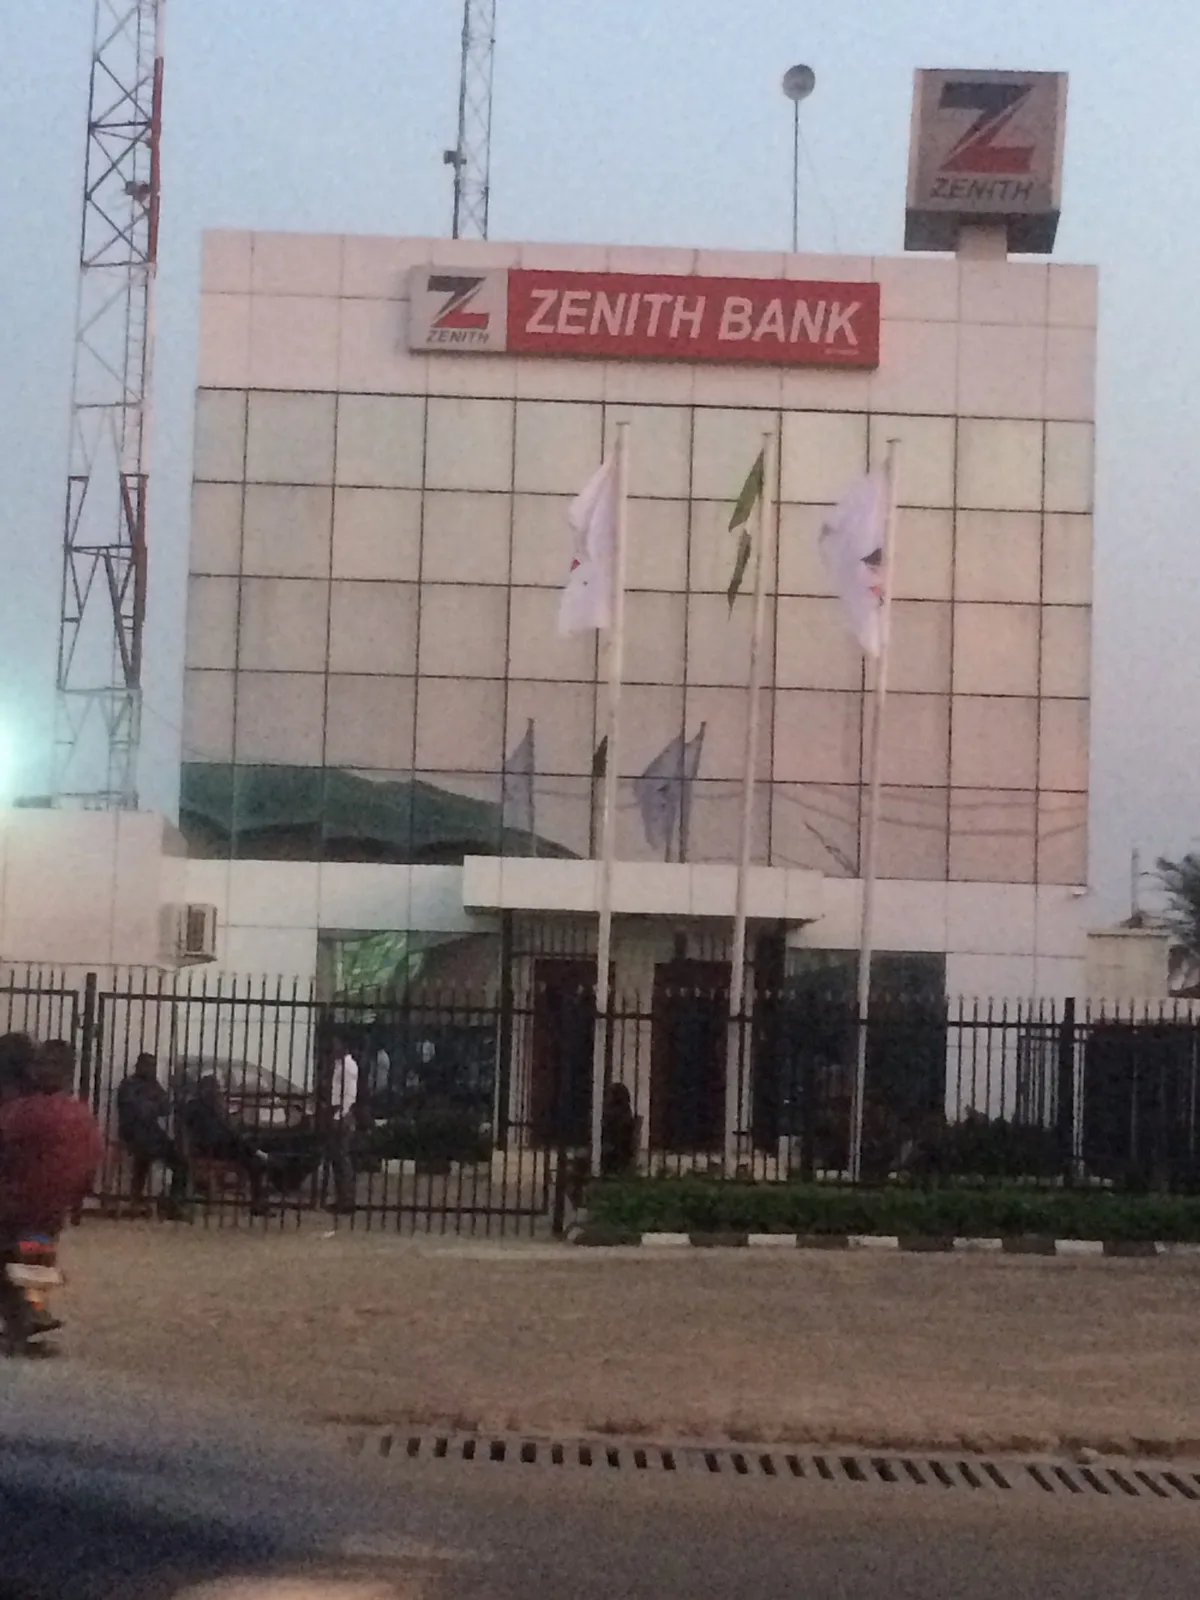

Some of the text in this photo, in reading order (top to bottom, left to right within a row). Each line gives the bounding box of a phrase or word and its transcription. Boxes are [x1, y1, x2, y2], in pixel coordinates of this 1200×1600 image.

[930, 178, 1034, 200] ZENITH
[525, 289, 859, 346] ZENITH BANK
[426, 330, 490, 344] ZENITH
